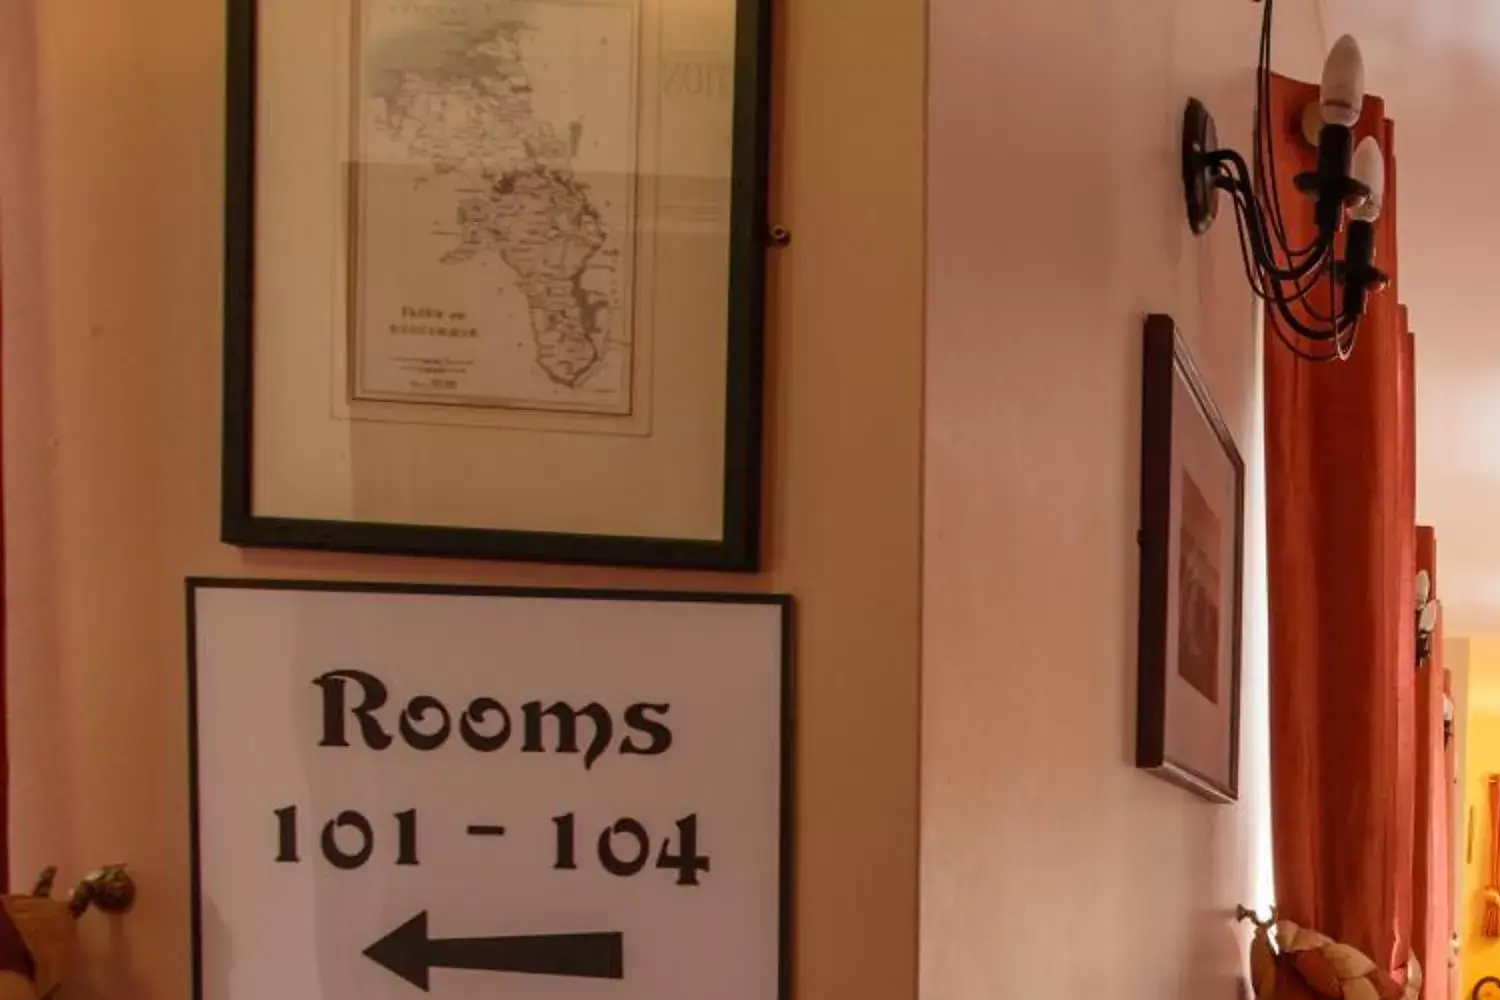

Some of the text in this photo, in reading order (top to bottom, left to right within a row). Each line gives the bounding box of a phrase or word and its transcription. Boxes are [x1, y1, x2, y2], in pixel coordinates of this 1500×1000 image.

[312, 669, 673, 771] Rooms
[273, 804, 421, 870] 101
[551, 812, 710, 887] 104
